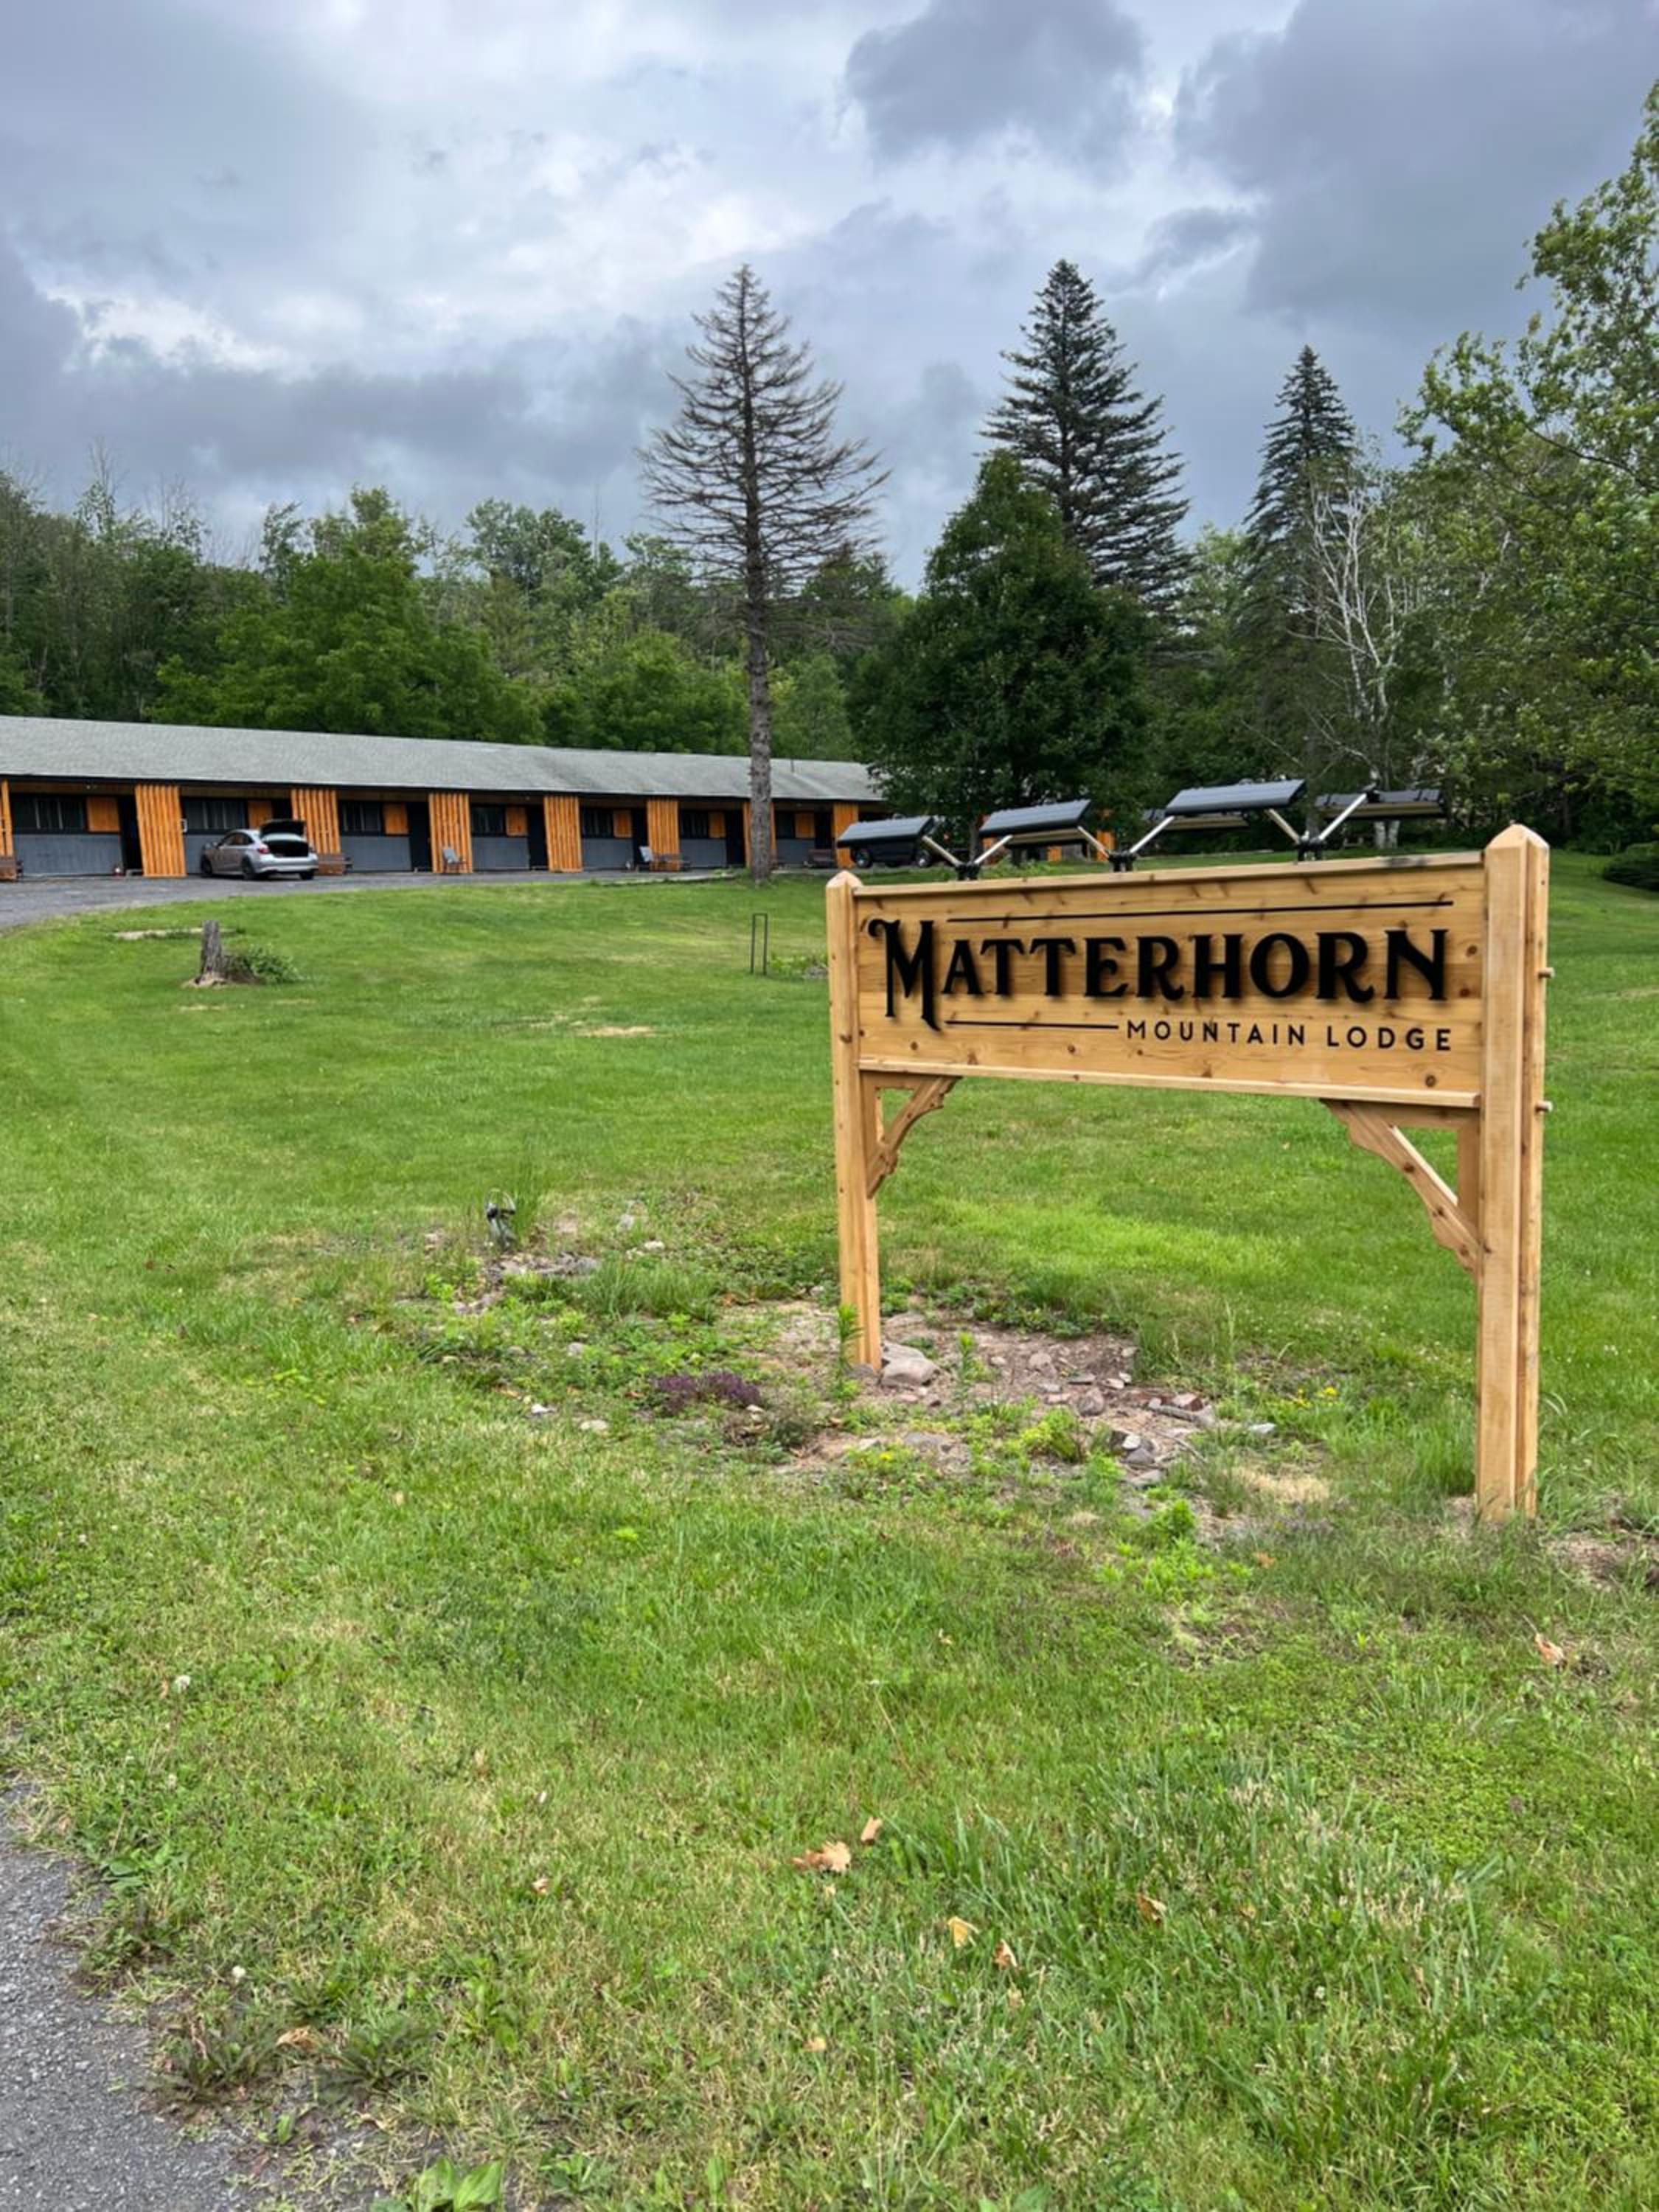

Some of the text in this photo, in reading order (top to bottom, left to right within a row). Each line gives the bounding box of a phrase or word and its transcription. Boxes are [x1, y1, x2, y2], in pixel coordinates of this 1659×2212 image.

[867, 918, 1448, 1031] MATTERHORN
[1127, 1020, 1451, 1051] MOUNTAIN LODGE
